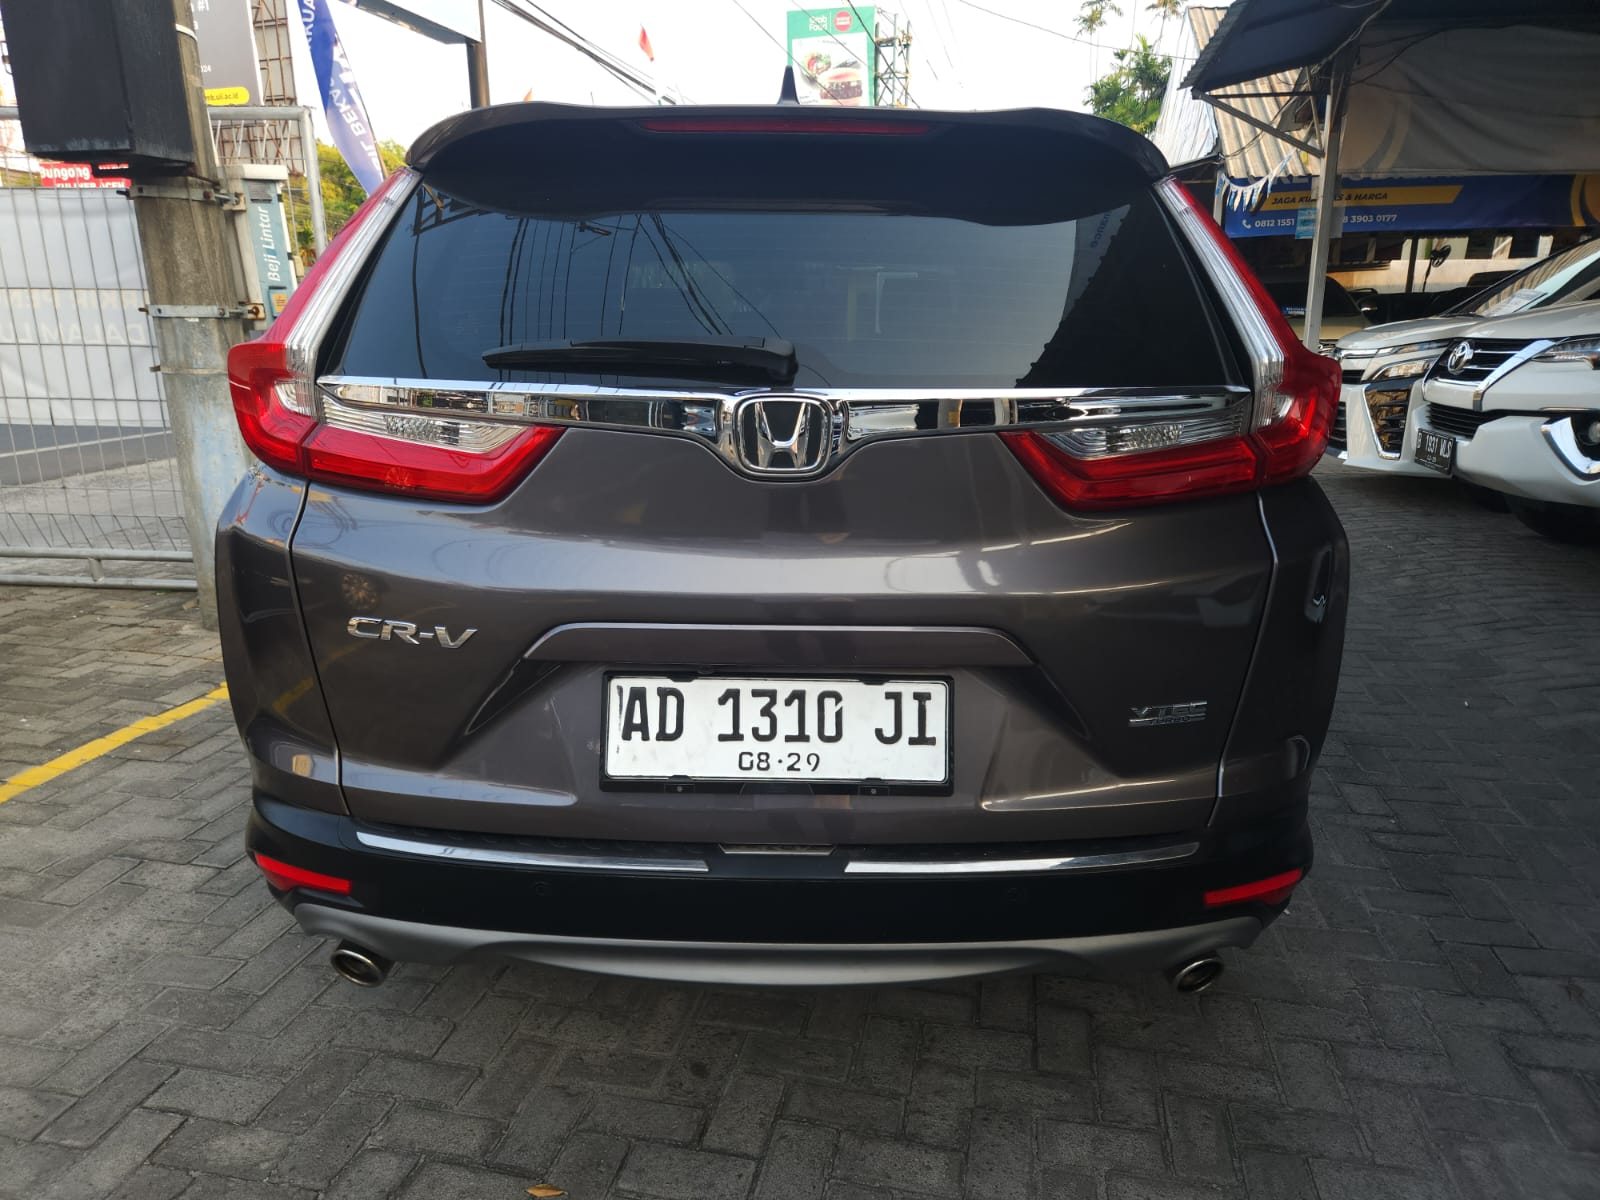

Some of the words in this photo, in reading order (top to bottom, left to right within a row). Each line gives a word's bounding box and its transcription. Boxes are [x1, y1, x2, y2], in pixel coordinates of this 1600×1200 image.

[40, 166, 91, 181] Bungong
[1254, 219, 1276, 228] 0812
[1277, 217, 1296, 227] 1551
[1376, 214, 1398, 223] 0177
[346, 616, 478, 649] CR-V
[621, 686, 685, 742] AD
[717, 687, 844, 744] 1310
[874, 690, 937, 746] JI
